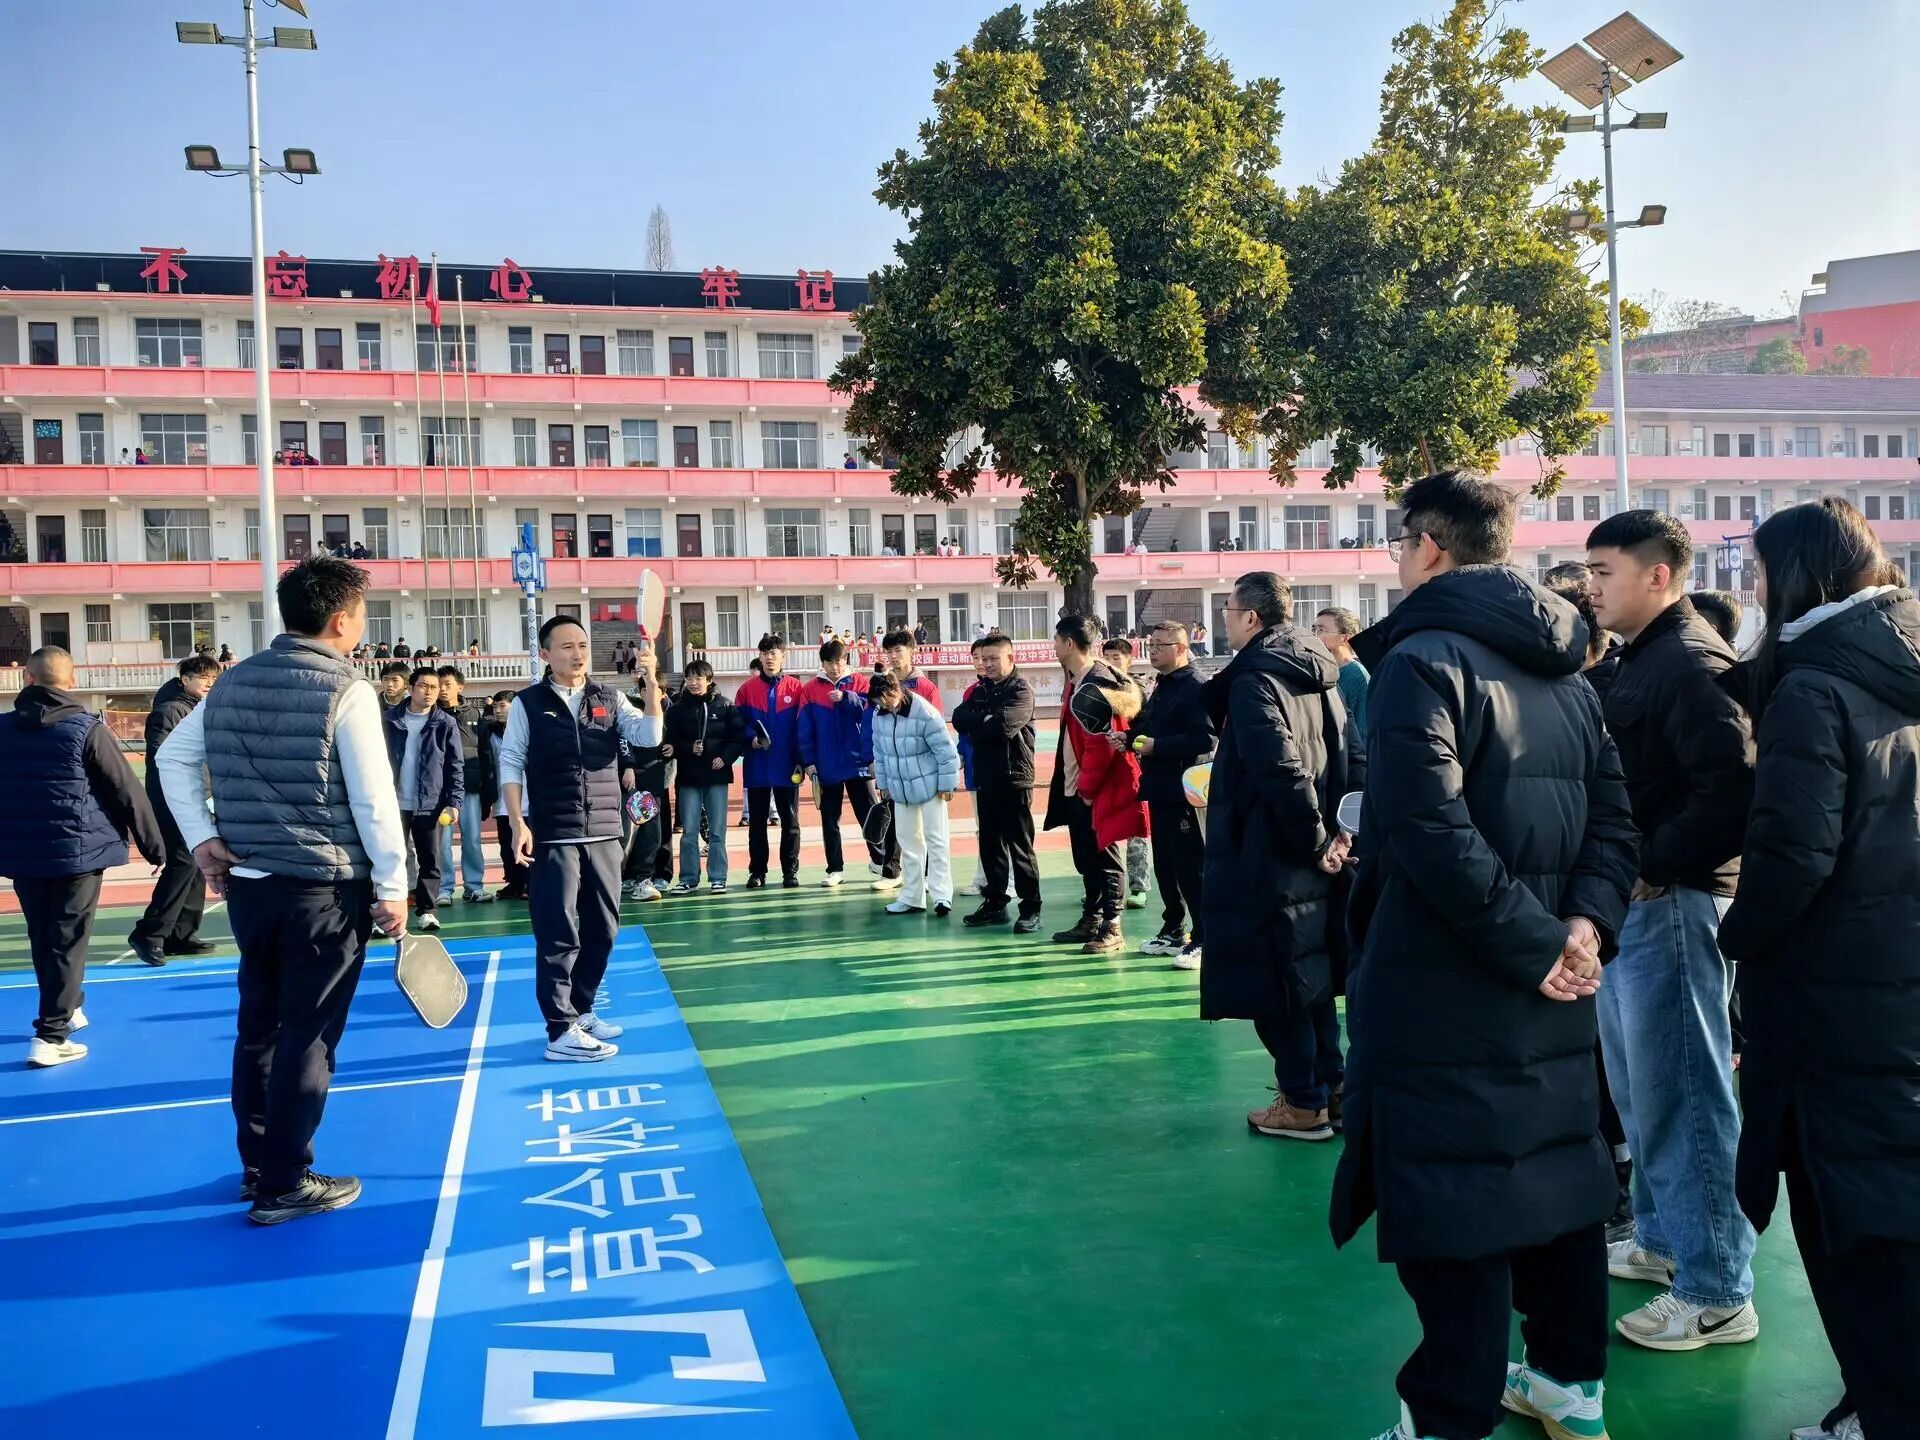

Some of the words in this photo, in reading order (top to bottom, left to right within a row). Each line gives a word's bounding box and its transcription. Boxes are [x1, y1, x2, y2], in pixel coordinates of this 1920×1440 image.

[139, 246, 533, 301] 不忘初心
[700, 265, 836, 311] 牢记
[511, 1083, 716, 1294] 竞合体育
